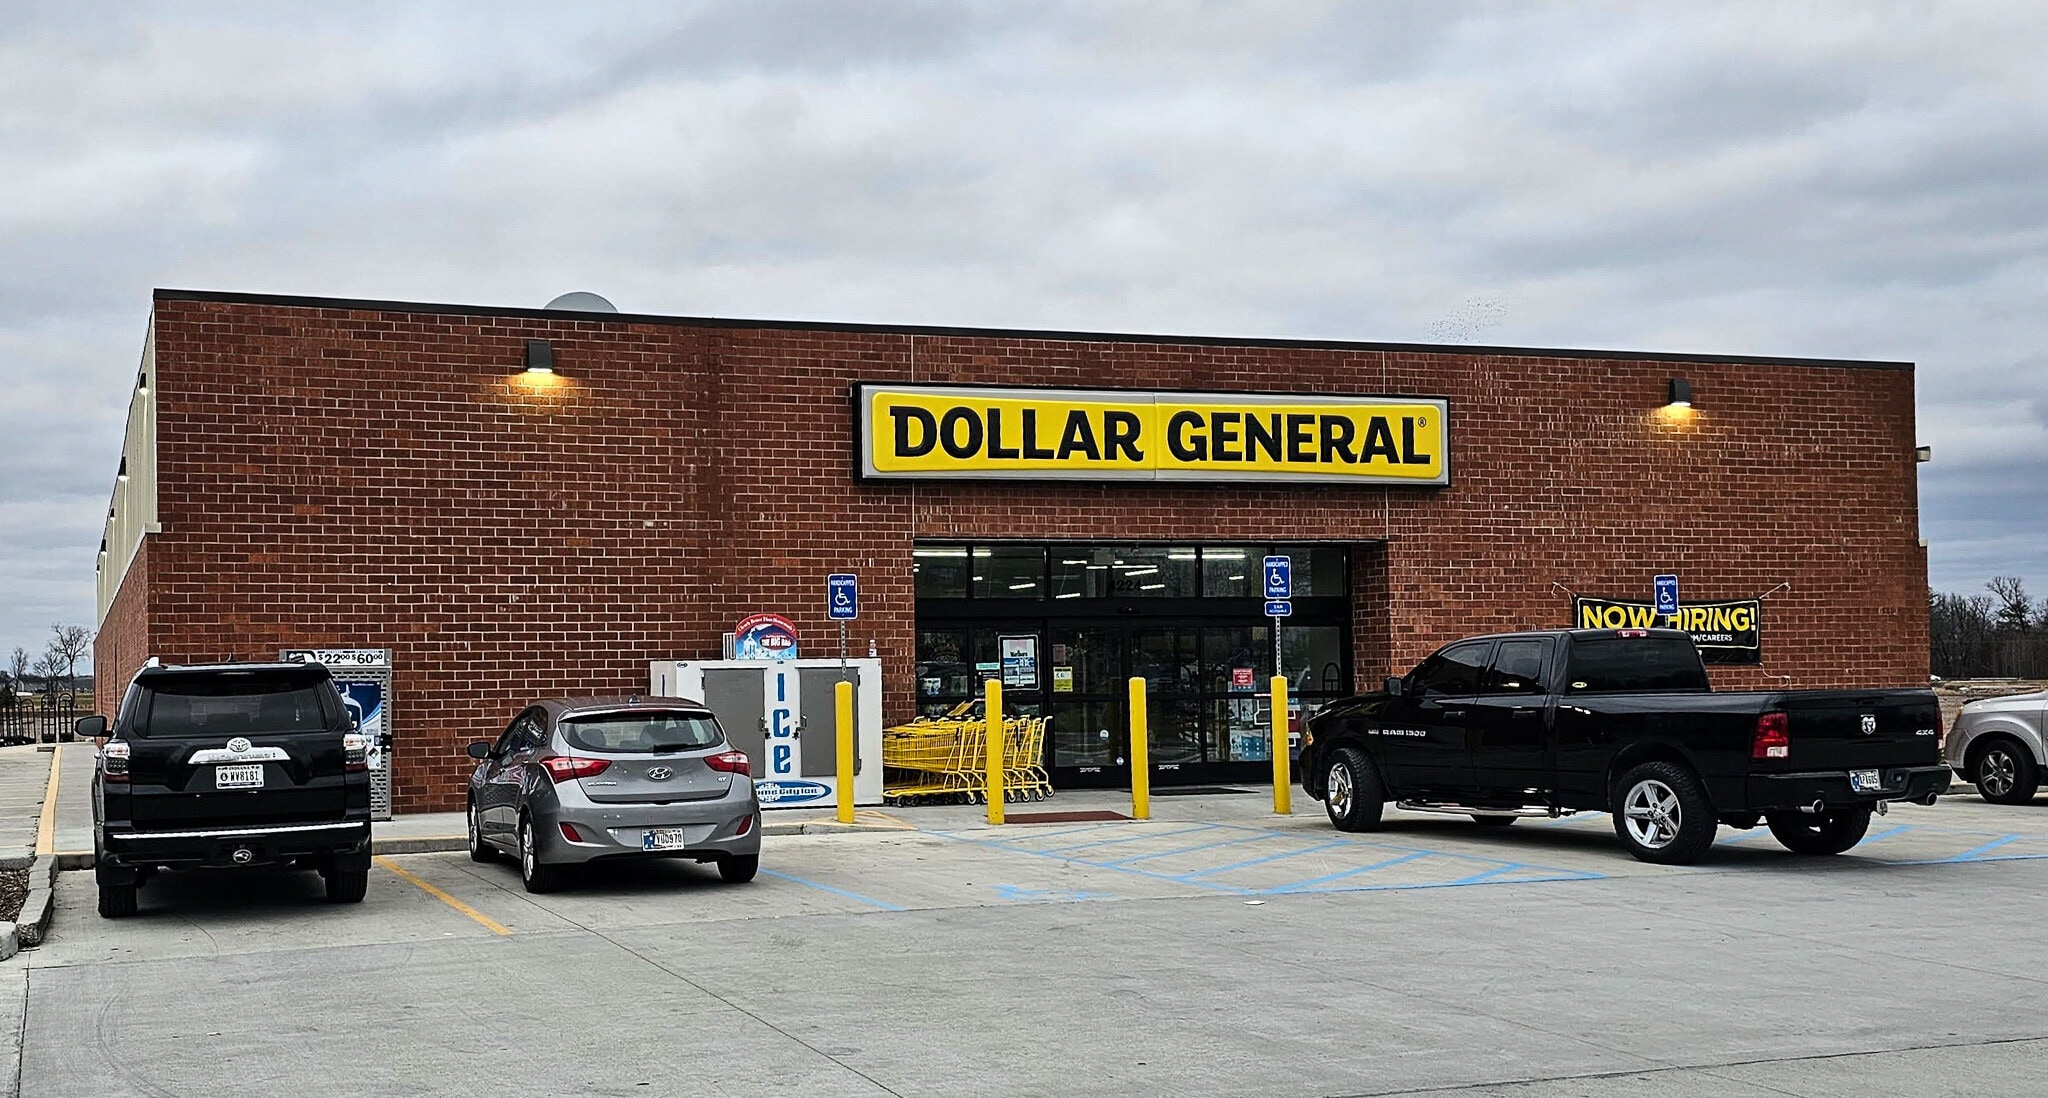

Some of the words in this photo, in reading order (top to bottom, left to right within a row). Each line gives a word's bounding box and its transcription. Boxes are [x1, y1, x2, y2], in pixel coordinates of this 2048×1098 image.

[889, 405, 1144, 462] DOLLAR
[1167, 410, 1430, 465] GENERAL
[833, 606, 853, 614] PARKING
[1582, 606, 1656, 629] NOW
[1667, 607, 1756, 632] HIRING!
[779, 788, 800, 797] City
